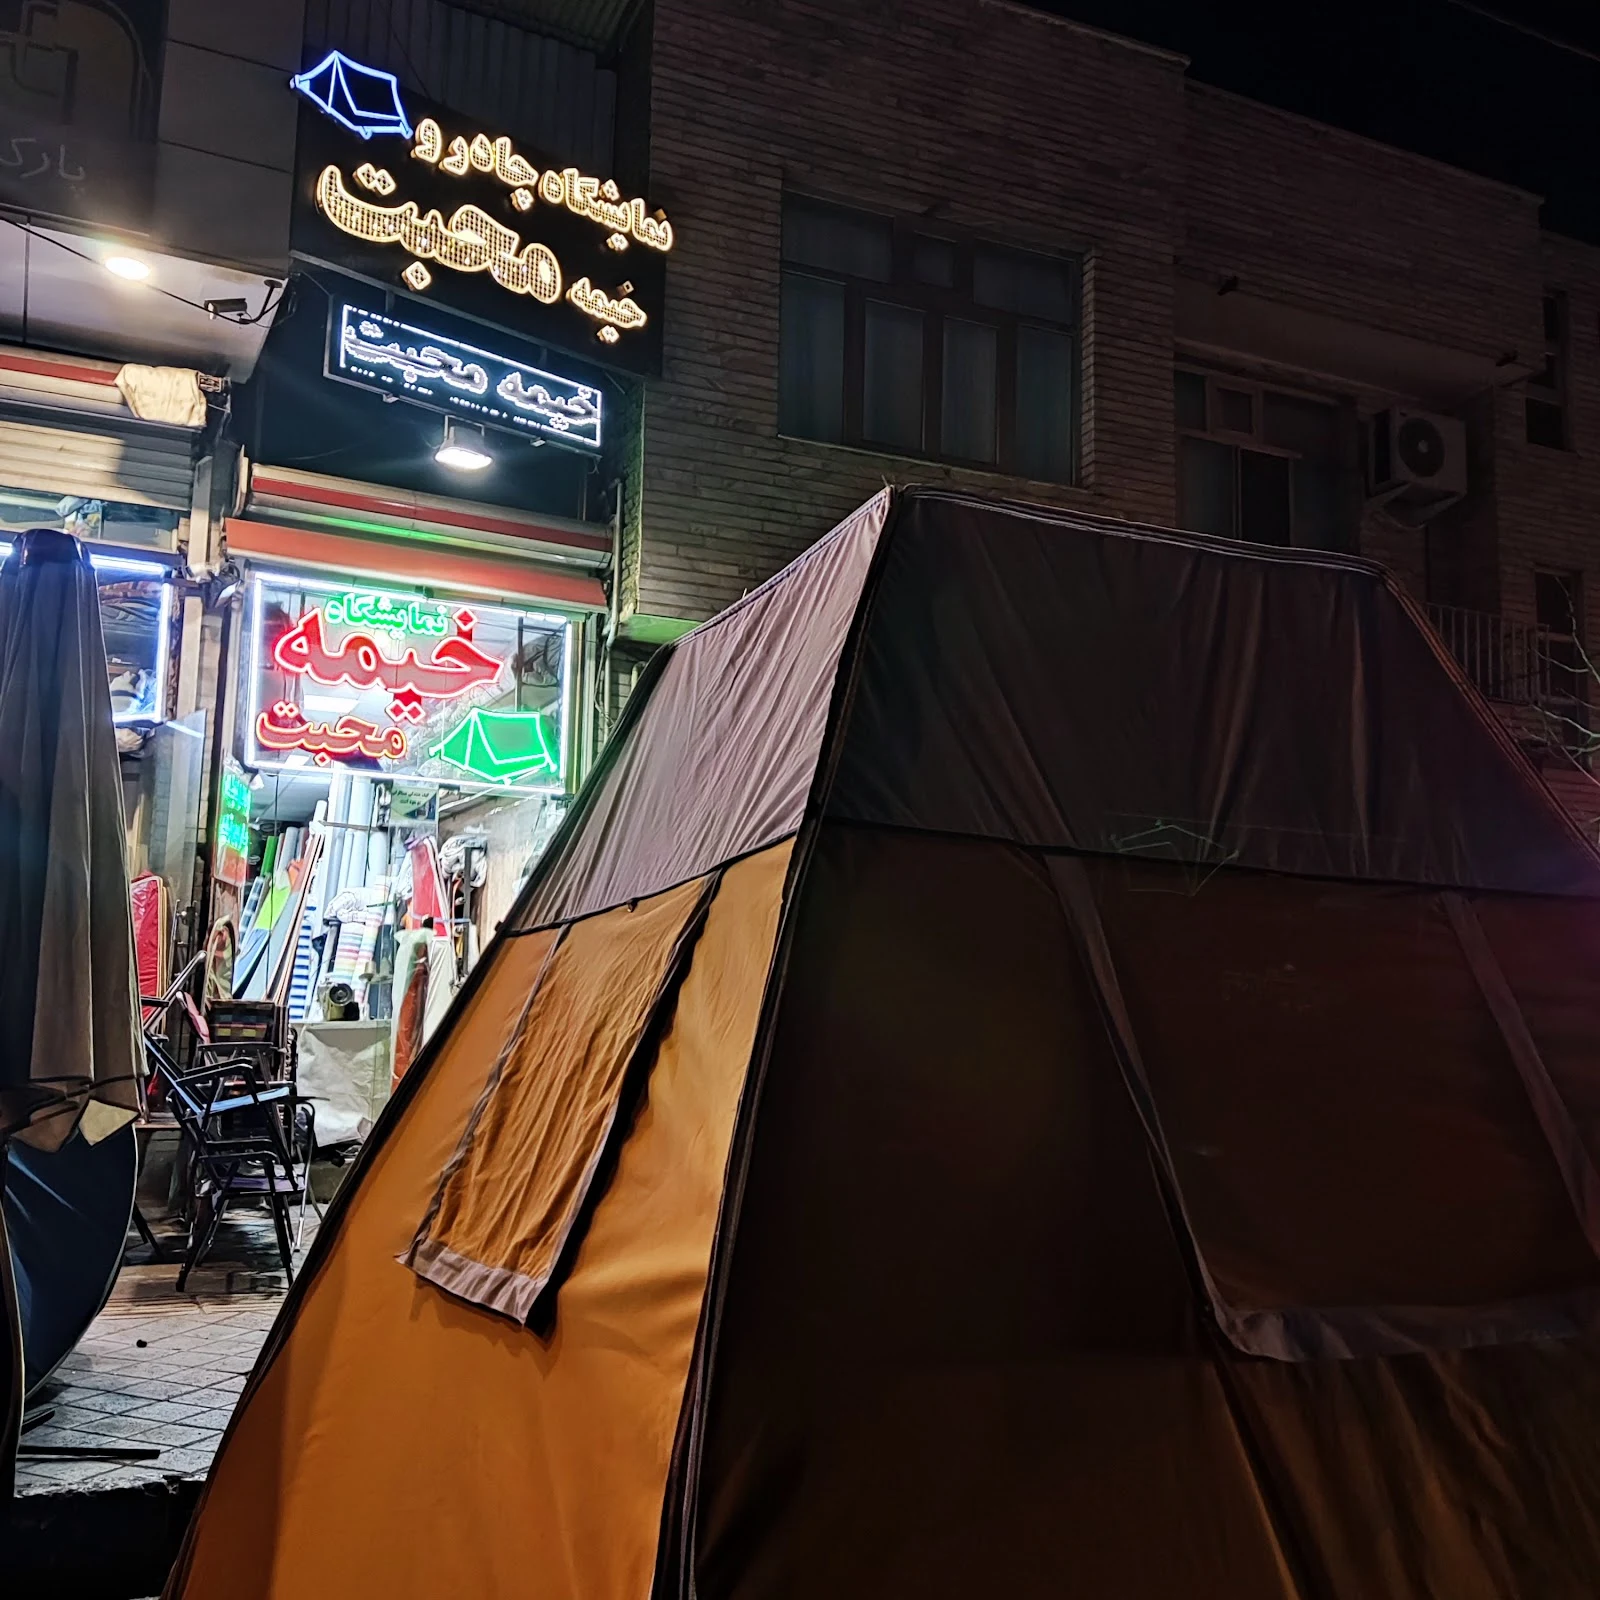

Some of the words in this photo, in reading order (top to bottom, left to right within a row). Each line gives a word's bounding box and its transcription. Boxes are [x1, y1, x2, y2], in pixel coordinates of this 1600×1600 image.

[439, 133, 539, 211] چادر
[538, 167, 673, 251] نمایشگاه
[316, 162, 562, 304] محبت
[566, 277, 647, 344] خیمه
[343, 320, 489, 394] محبت
[496, 371, 601, 431] خیمه
[325, 592, 449, 639] نمایشگاه
[274, 607, 503, 725] خیمه
[255, 701, 407, 767] محبت
